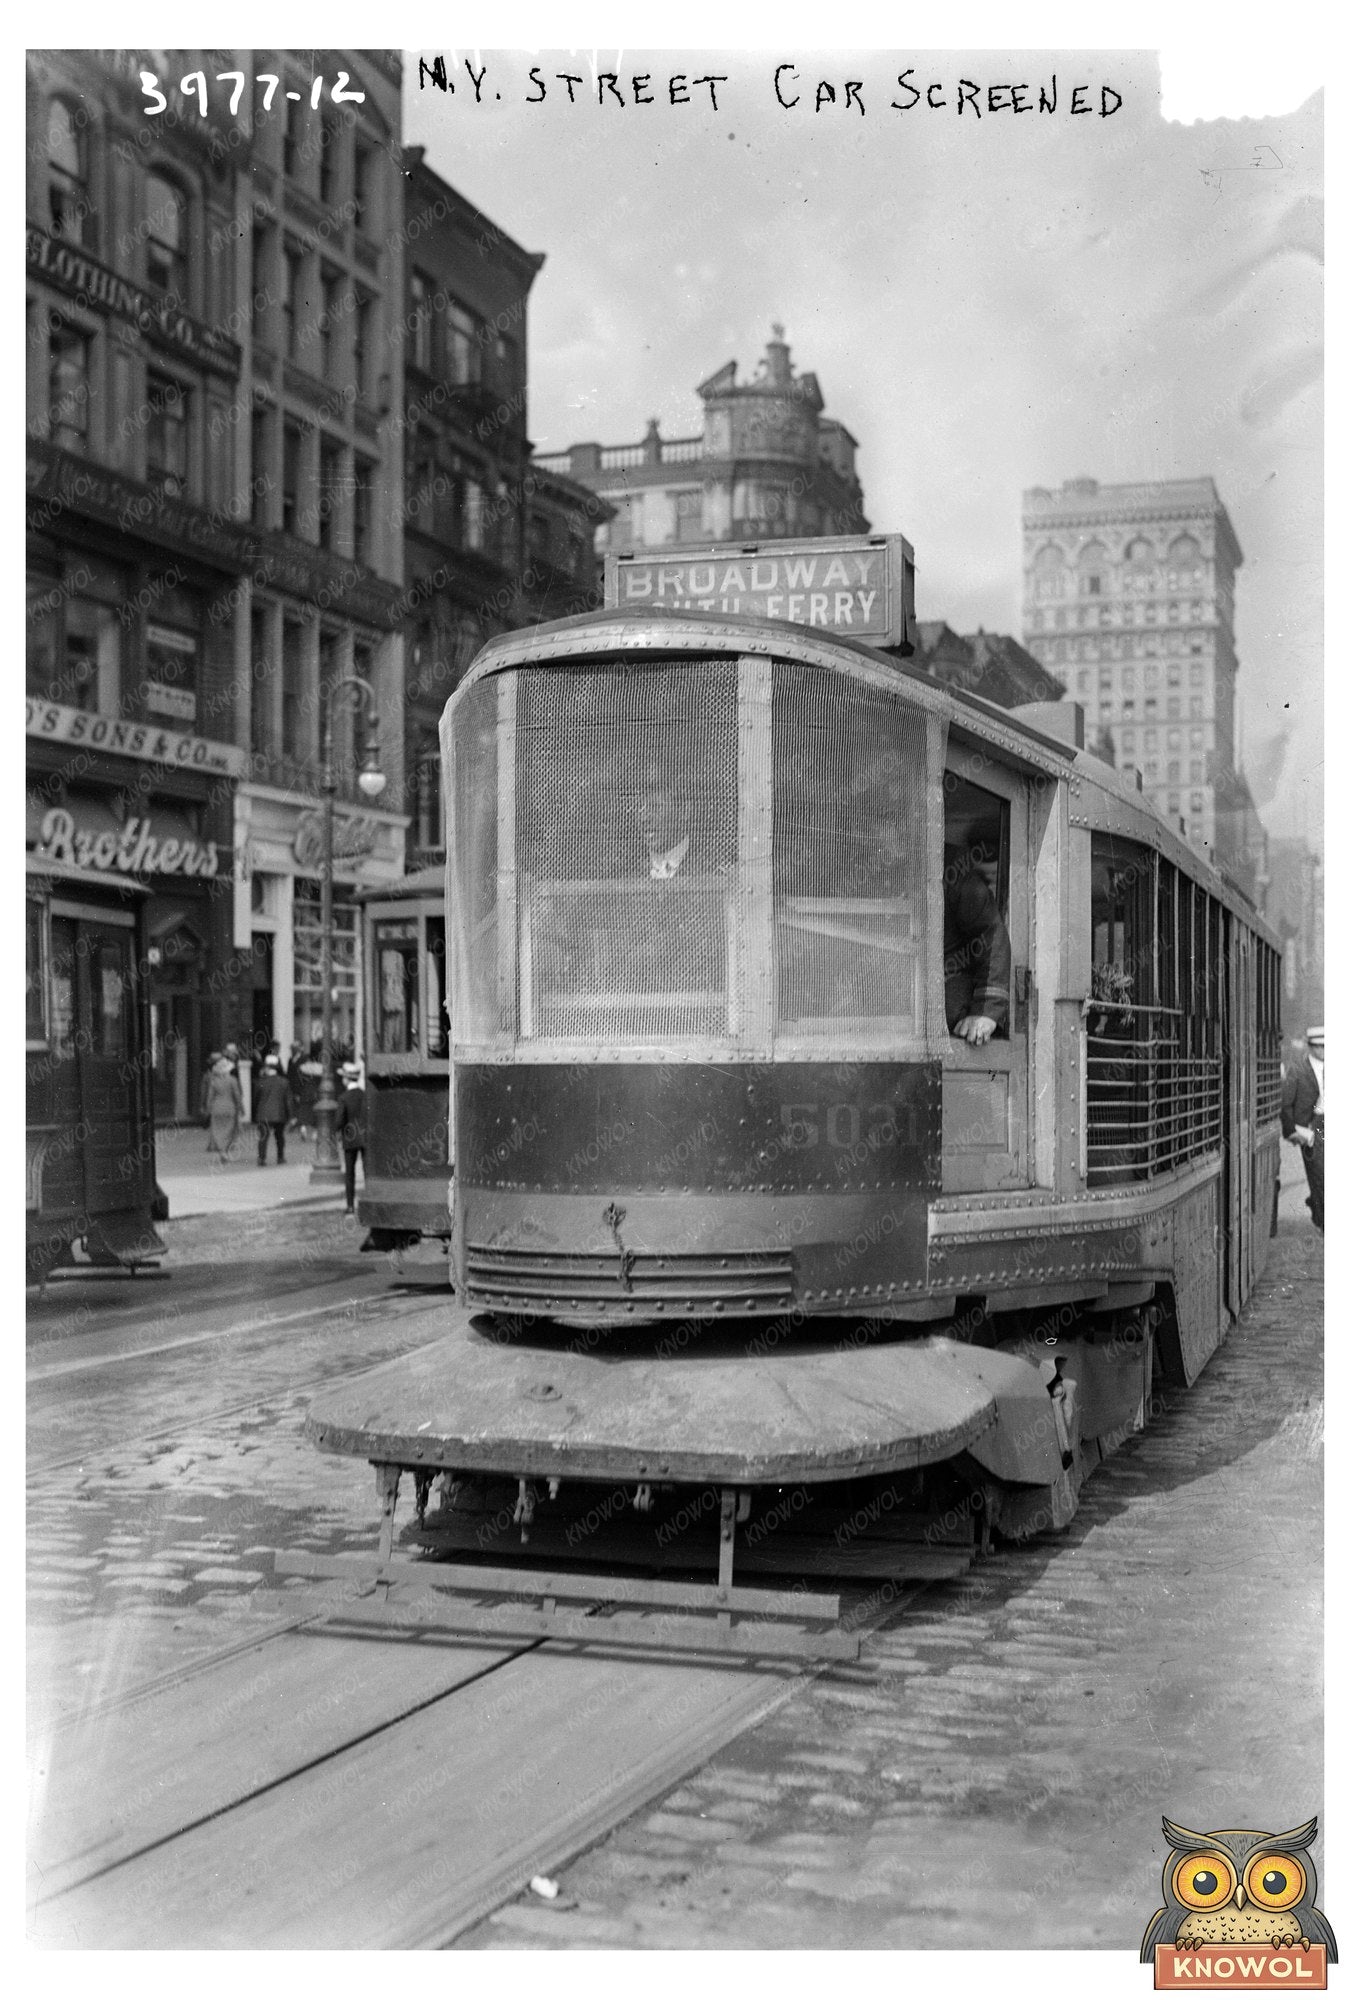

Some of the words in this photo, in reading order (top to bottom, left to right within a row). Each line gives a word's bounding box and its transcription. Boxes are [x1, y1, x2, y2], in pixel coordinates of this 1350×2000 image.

[139, 70, 366, 117] 3977-12
[526, 68, 728, 111] STREET
[891, 70, 1123, 119] SCREENED
[767, 590, 878, 626] FERRY
[70, 713, 146, 752] SONS
[153, 733, 169, 757] &
[41, 807, 218, 877] Brothers
